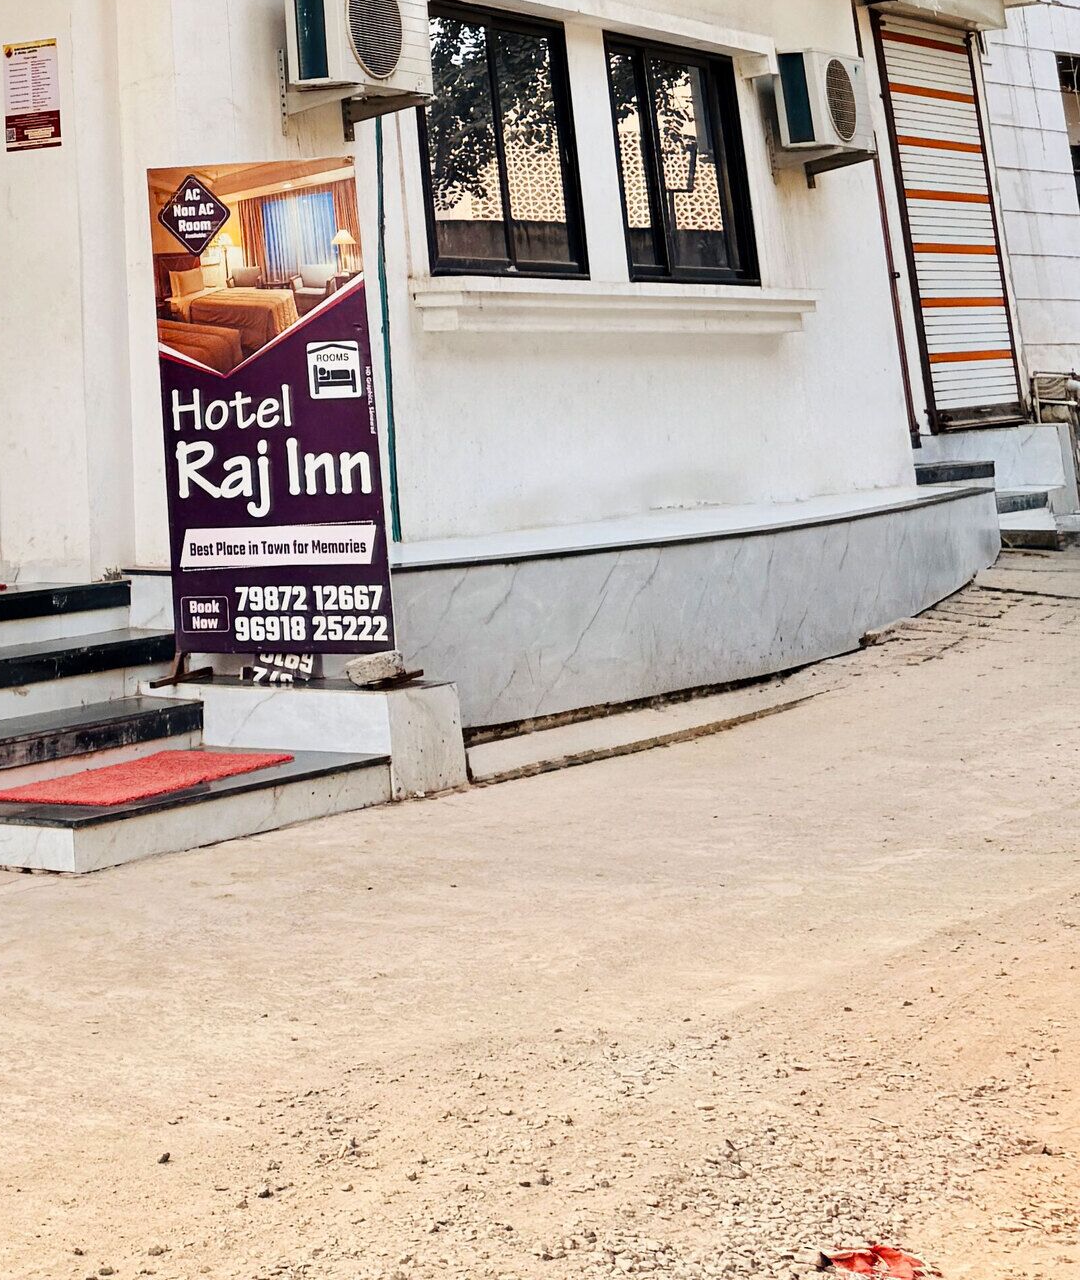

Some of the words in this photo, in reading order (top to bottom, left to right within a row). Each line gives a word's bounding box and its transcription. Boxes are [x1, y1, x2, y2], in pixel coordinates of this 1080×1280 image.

[185, 189, 200, 201] AC
[173, 204, 195, 217] Non
[199, 203, 214, 215] AC
[178, 220, 211, 232] Room
[316, 353, 349, 363] ROOMS
[172, 384, 291, 430] Hotel
[176, 440, 270, 517] Raj
[286, 438, 371, 495] Inn
[189, 542, 213, 556] Best
[216, 541, 246, 555] Place
[249, 541, 259, 554] in
[261, 541, 290, 554] Town
[292, 540, 309, 554] for
[312, 539, 366, 554] Memories
[235, 586, 307, 611] 79872
[313, 585, 382, 610] 12667
[189, 600, 219, 614] Book
[192, 616, 218, 630] Now
[235, 616, 306, 641] 96918
[313, 616, 388, 641] 25222
